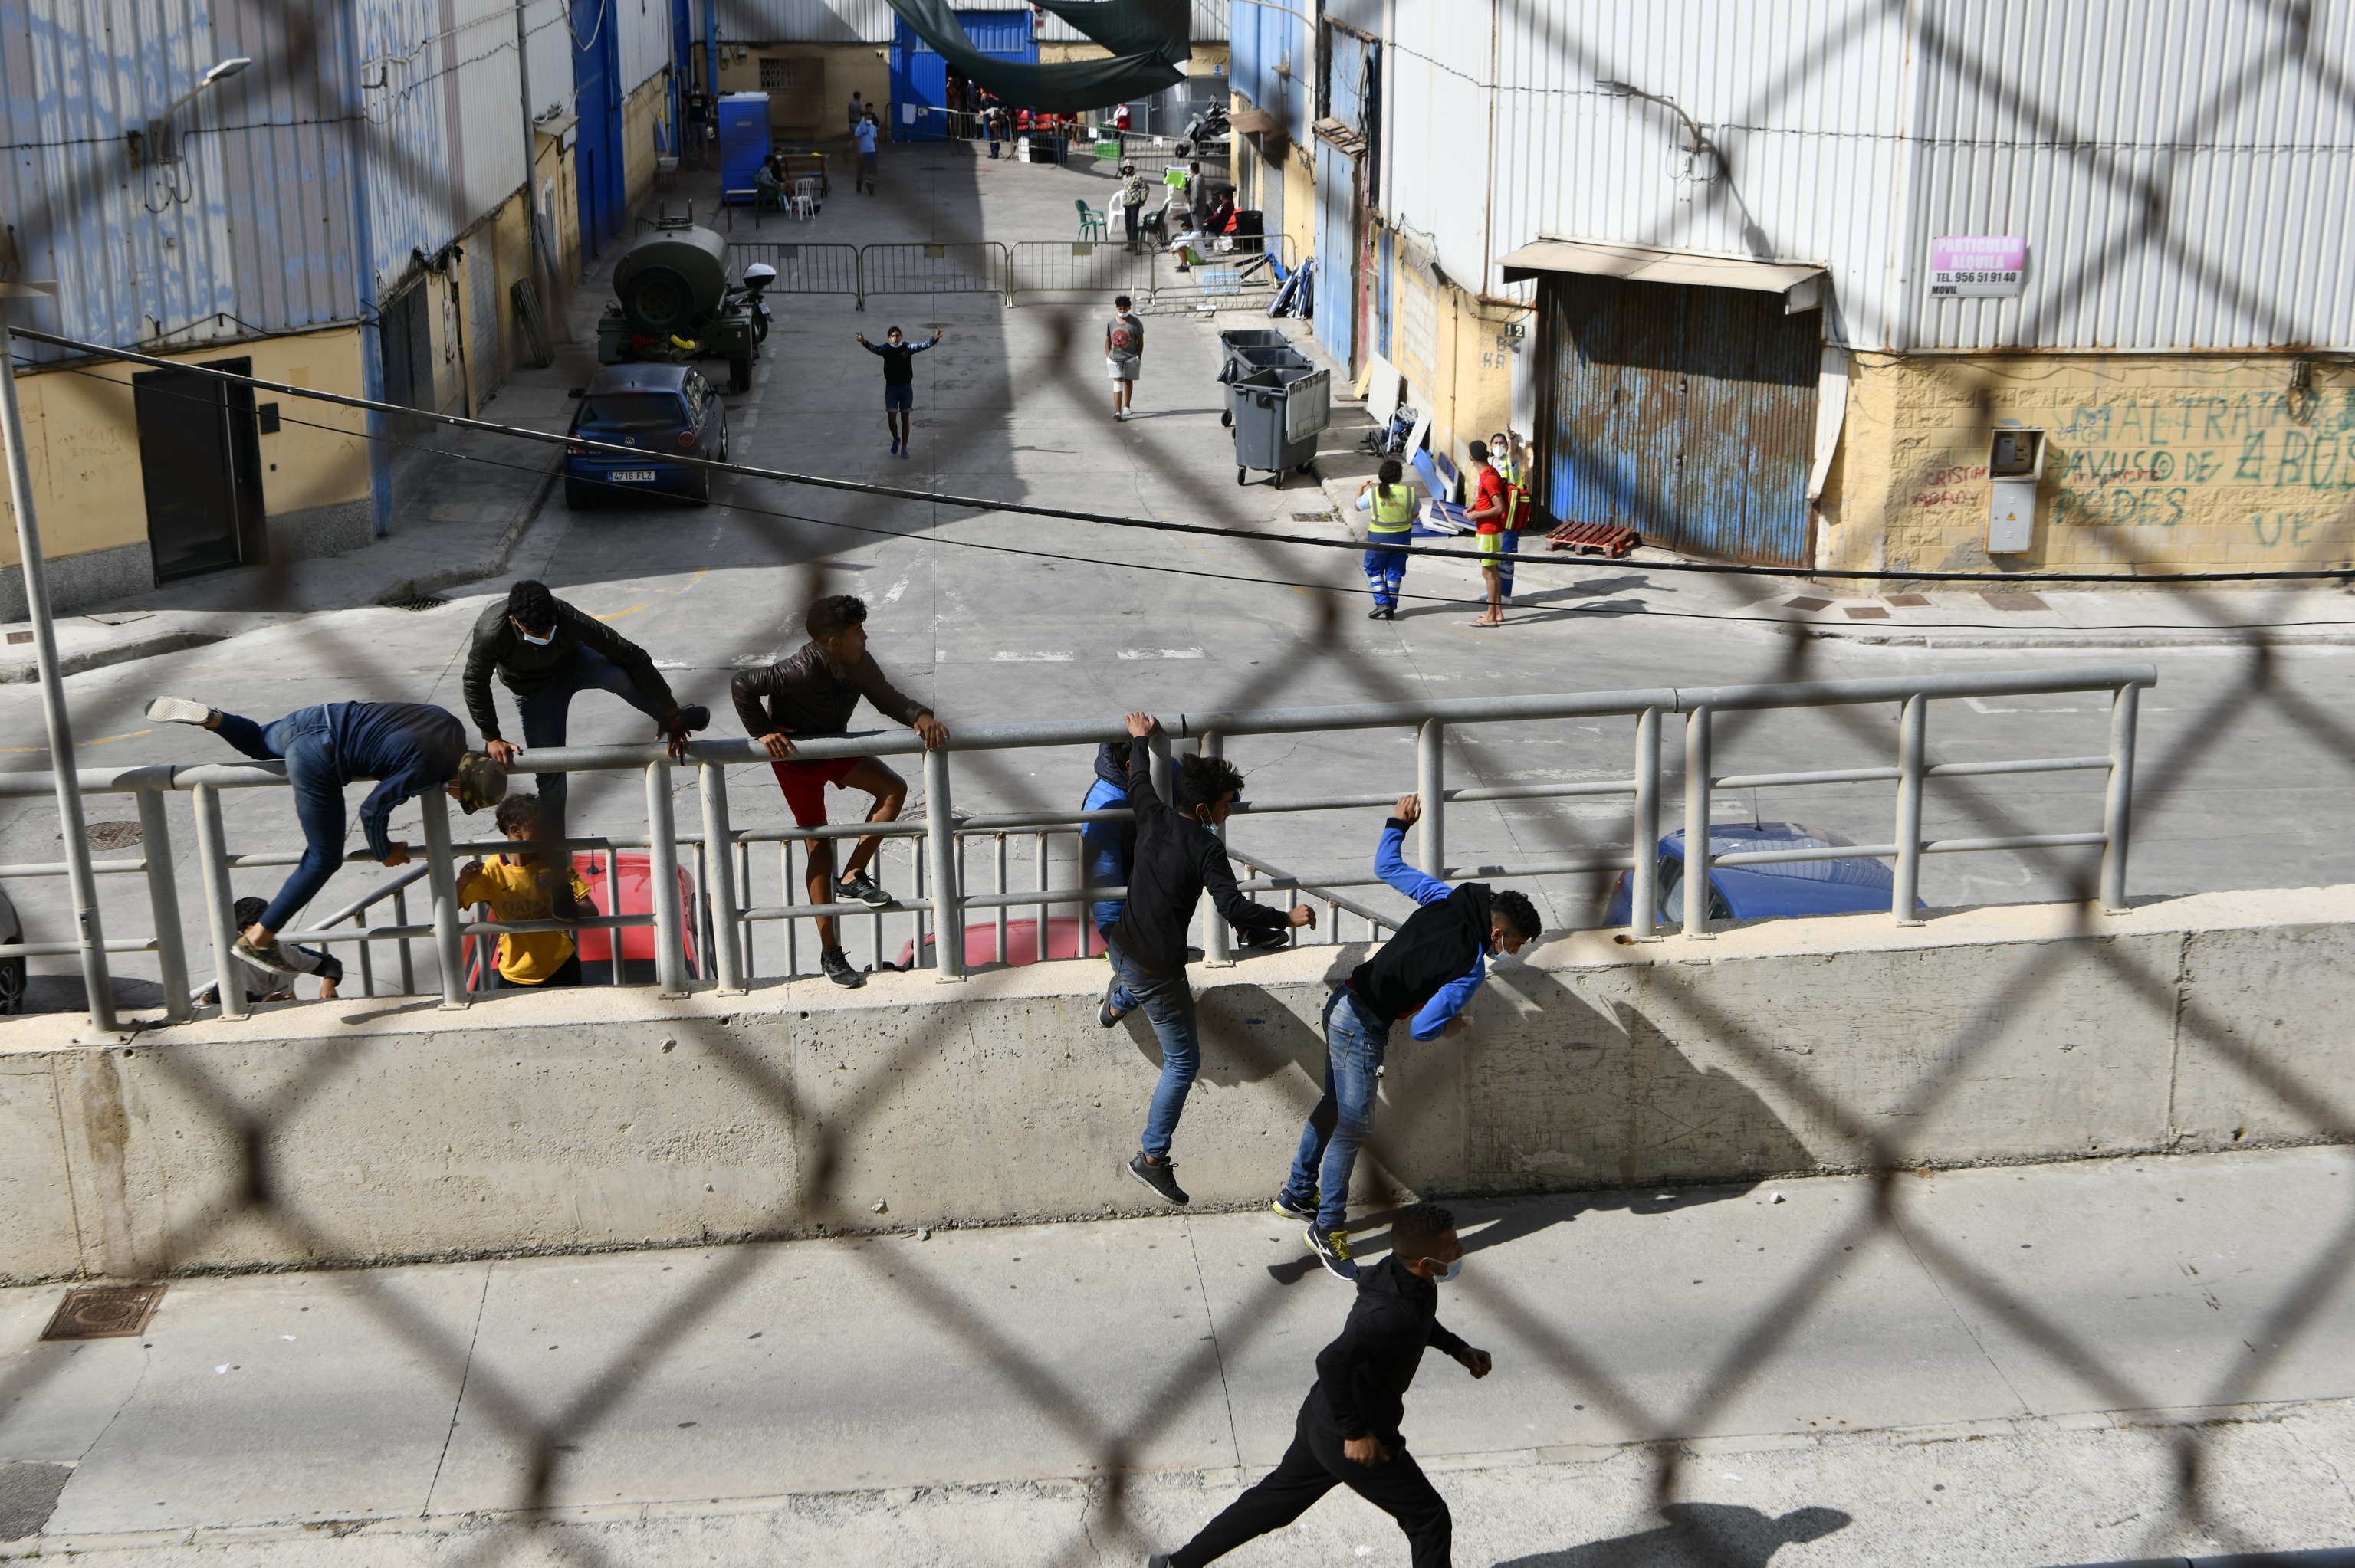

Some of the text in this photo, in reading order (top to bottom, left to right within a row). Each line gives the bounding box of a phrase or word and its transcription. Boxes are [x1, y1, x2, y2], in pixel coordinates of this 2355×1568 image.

[1937, 238, 2020, 253] PARTICULAR
[1950, 255, 2005, 270] ALQUILA
[1936, 272, 2016, 283] TEL. 956 51 91 40
[1931, 285, 1957, 295] MOVIL
[614, 471, 652, 481] 4716 FLZ
